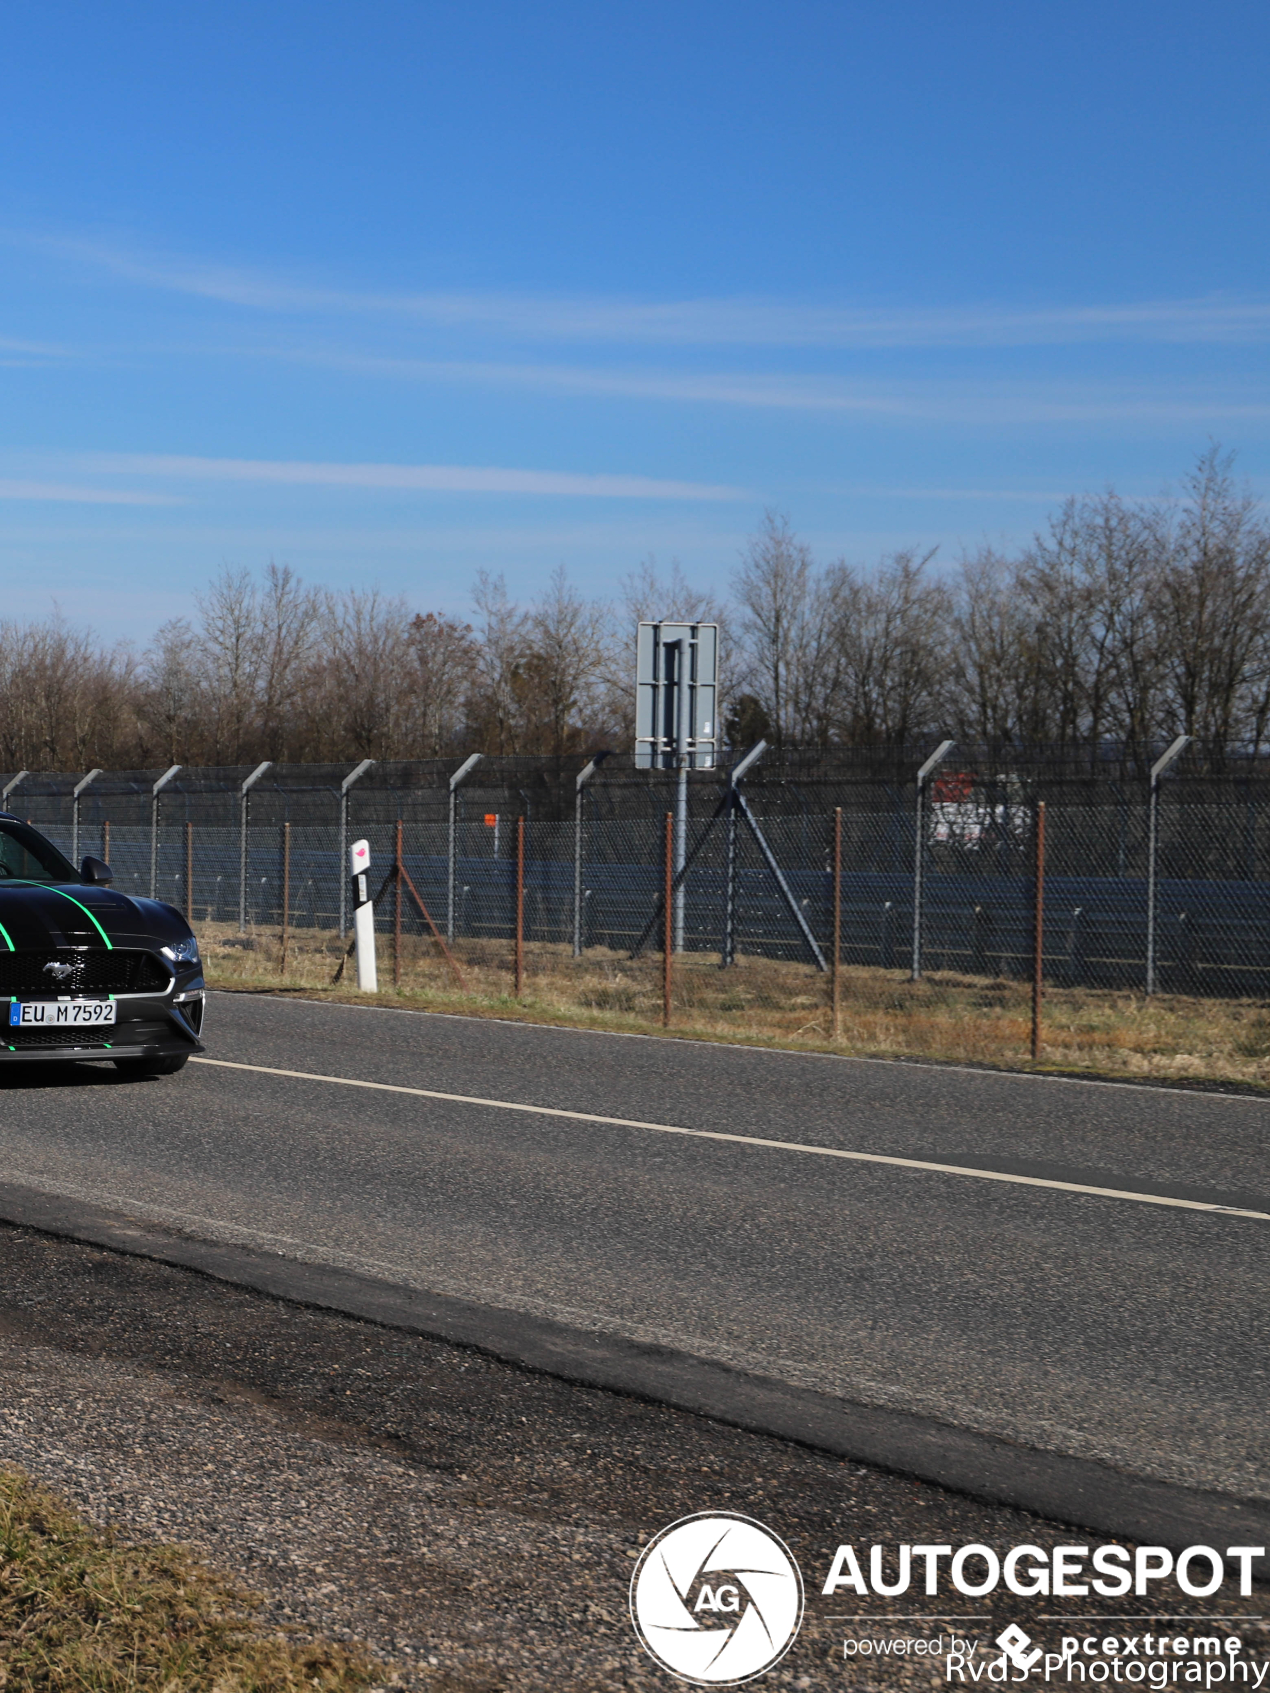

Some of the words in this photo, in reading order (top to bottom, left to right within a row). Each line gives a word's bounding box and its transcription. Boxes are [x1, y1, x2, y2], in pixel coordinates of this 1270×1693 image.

[21, 1005, 45, 1023] EU
[57, 1005, 68, 1022] M
[72, 1004, 113, 1022] 7592
